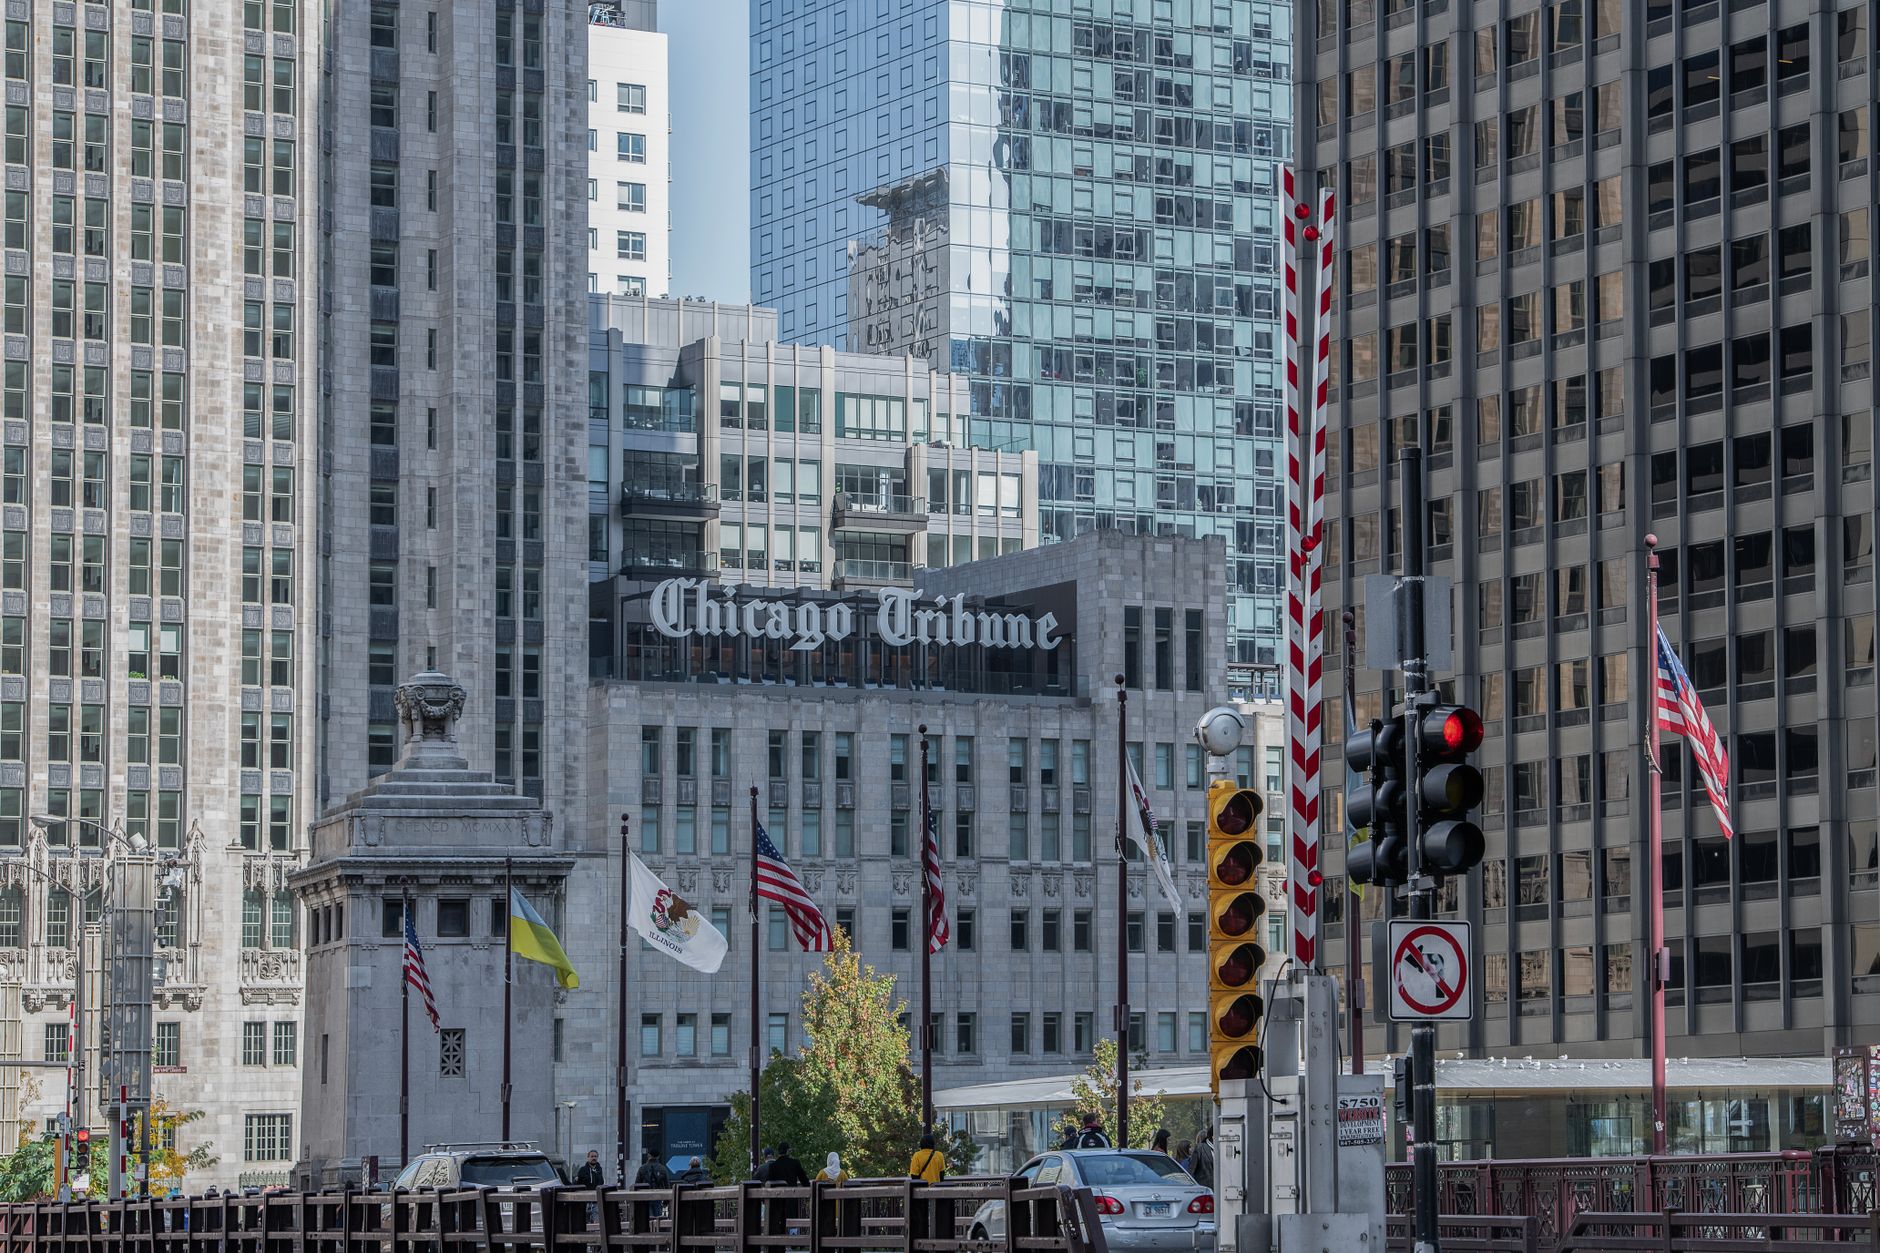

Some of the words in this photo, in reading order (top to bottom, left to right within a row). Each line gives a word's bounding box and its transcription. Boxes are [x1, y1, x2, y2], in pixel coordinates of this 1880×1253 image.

[649, 576, 853, 651] Chicago
[876, 585, 1063, 651] Tribune
[396, 821, 449, 833] OPENED
[461, 822, 512, 833] MCMXX
[648, 931, 683, 954] ILLINOIS
[1339, 1097, 1379, 1109] $750
[1340, 1120, 1379, 1128] DEVELOPMENT
